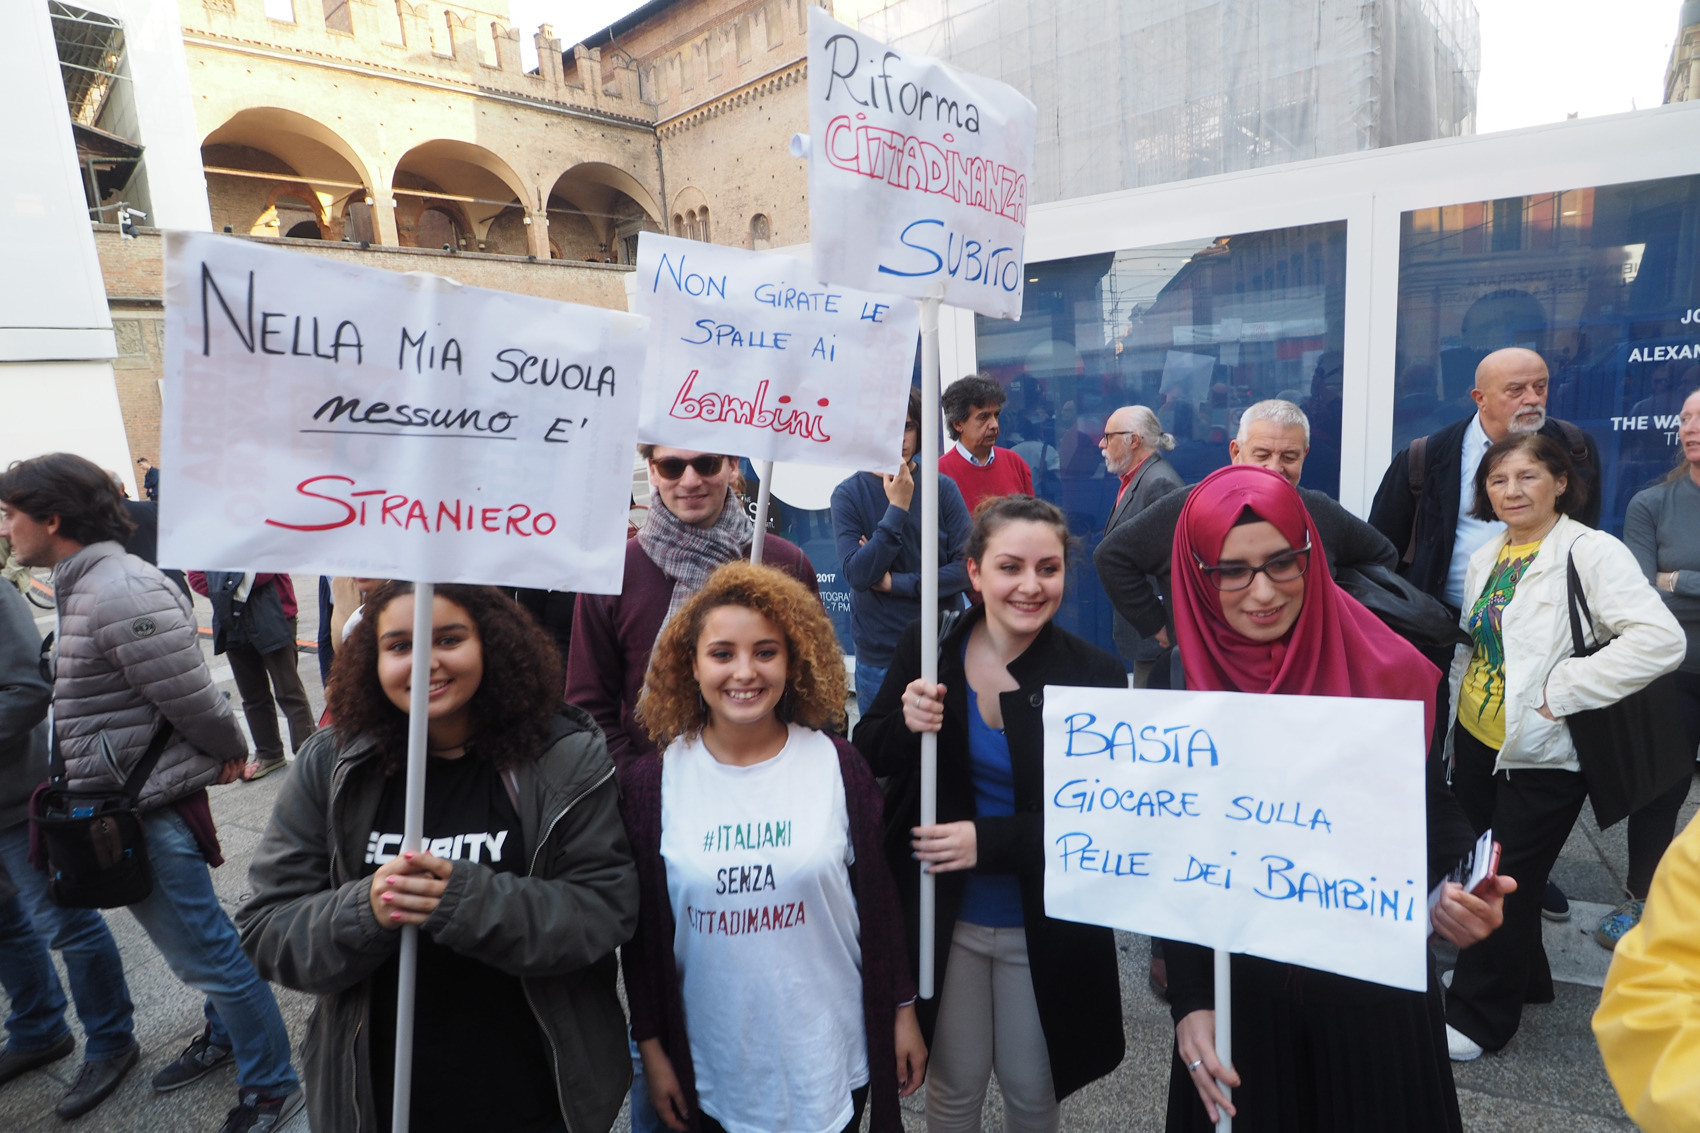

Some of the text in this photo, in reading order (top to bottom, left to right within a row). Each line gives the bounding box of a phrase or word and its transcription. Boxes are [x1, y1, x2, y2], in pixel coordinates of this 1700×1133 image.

[824, 33, 981, 135] Riforma
[653, 253, 727, 300] NON
[860, 302, 890, 323] LE
[200, 260, 364, 366] NELLA
[490, 347, 616, 397] SCUOLA
[680, 319, 792, 351] SPALLE
[312, 394, 518, 435] nessuno
[668, 369, 831, 443] bambini
[1610, 416, 1649, 431] THE
[816, 573, 836, 583] 2017
[819, 591, 851, 602] TOGRA
[838, 602, 850, 612] PM
[1064, 711, 1219, 768] BASTA
[1225, 796, 1332, 833] SULLA
[703, 819, 792, 853] #ITALIANI
[1055, 831, 1152, 877] PELLE
[715, 863, 776, 896] SENZA
[687, 899, 806, 937] CITTADINANZA
